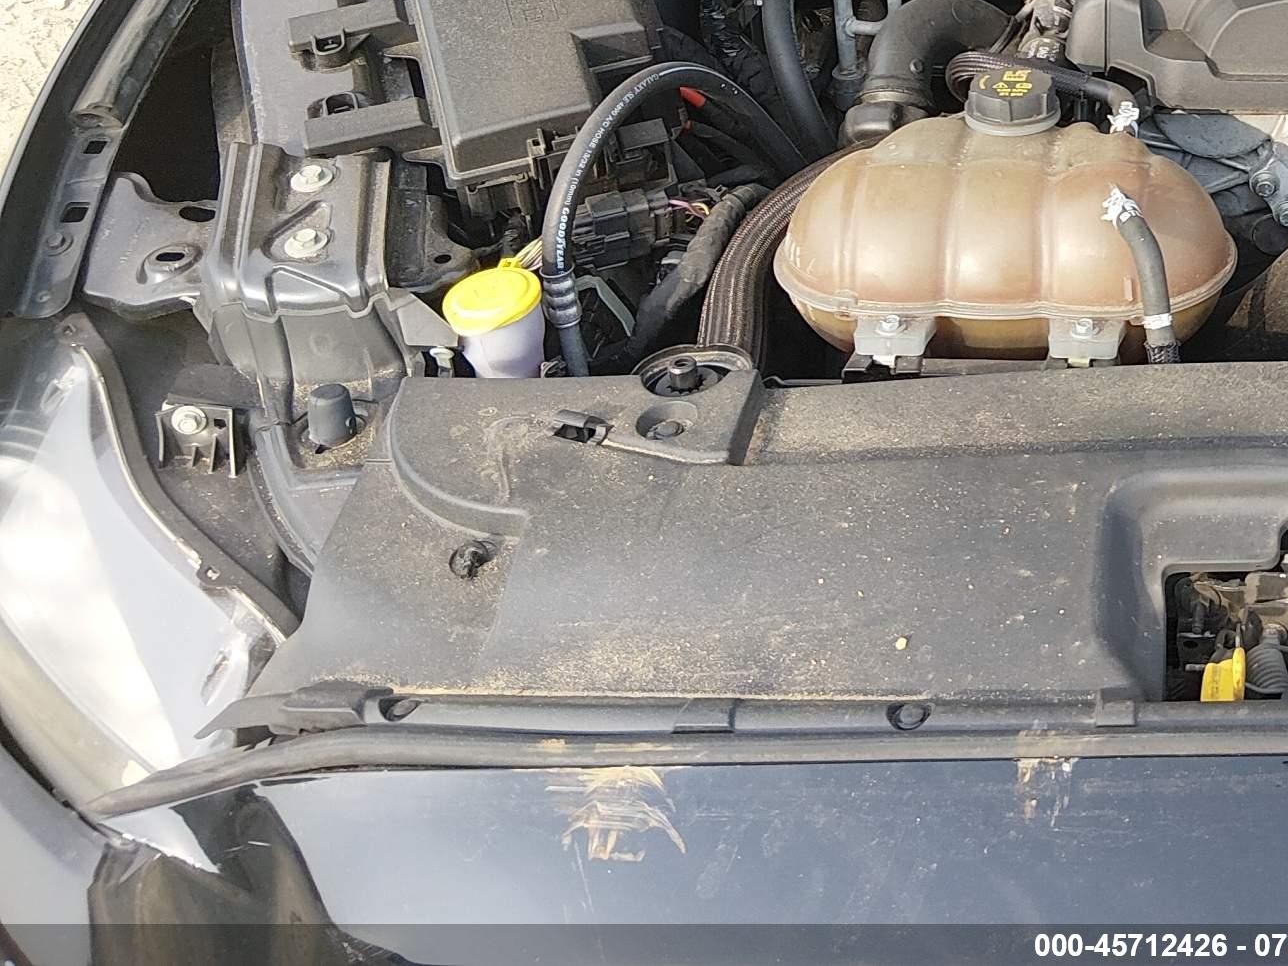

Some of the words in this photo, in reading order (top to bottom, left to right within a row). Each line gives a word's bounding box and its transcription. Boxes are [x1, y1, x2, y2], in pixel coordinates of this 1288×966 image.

[634, 73, 660, 95] GALAXY
[588, 127, 606, 149] HOSE
[578, 149, 593, 169] 13/32
[564, 177, 579, 205] (10mm)
[556, 207, 570, 269] GOODYEAR
